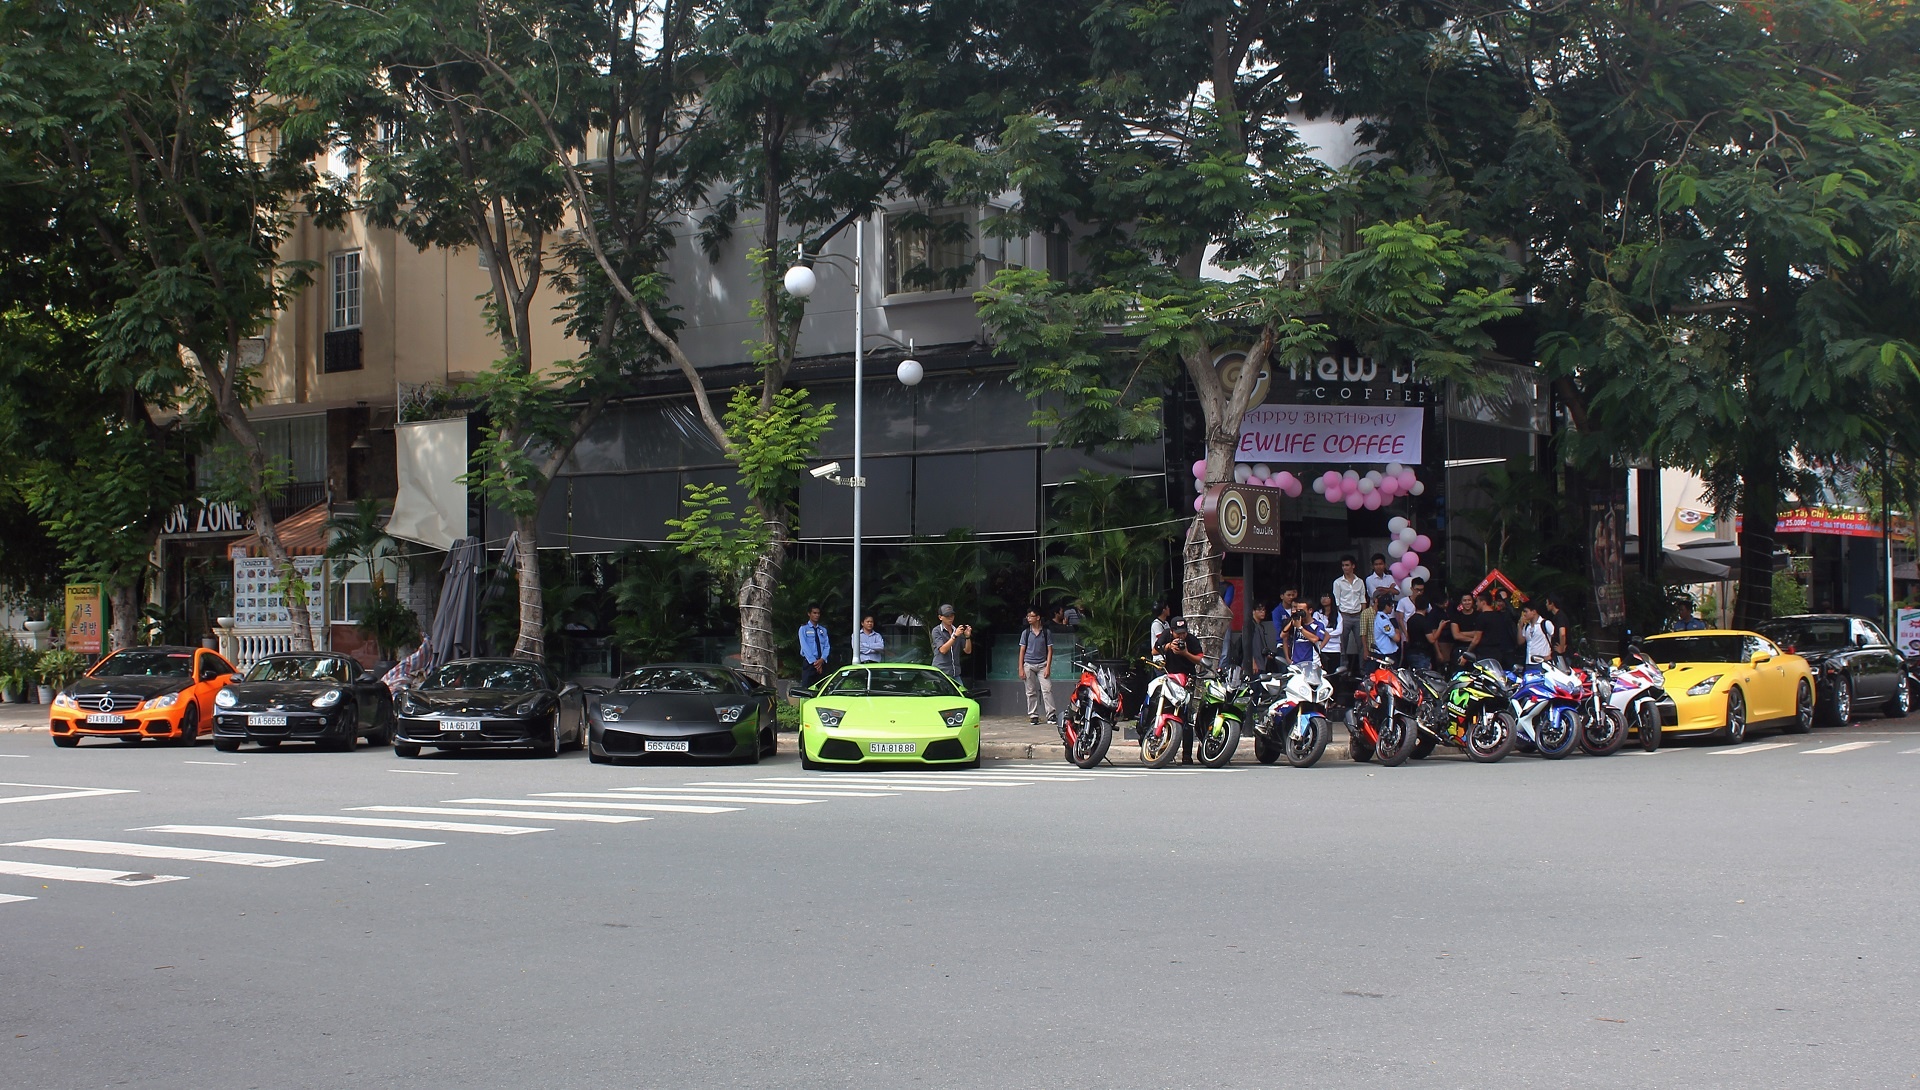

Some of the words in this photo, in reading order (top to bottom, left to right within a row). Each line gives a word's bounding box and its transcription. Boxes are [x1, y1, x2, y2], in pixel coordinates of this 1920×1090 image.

[1315, 386, 1425, 403] COFFEE
[1303, 411, 1397, 427] BIRTHDAY
[1240, 432, 1317, 454] EWLIFE
[1322, 434, 1406, 455] COFFEE
[160, 503, 188, 534] OW
[196, 498, 242, 532] ZONE
[71, 621, 97, 636] 노래방
[871, 743, 915, 753] 51A-818.88
